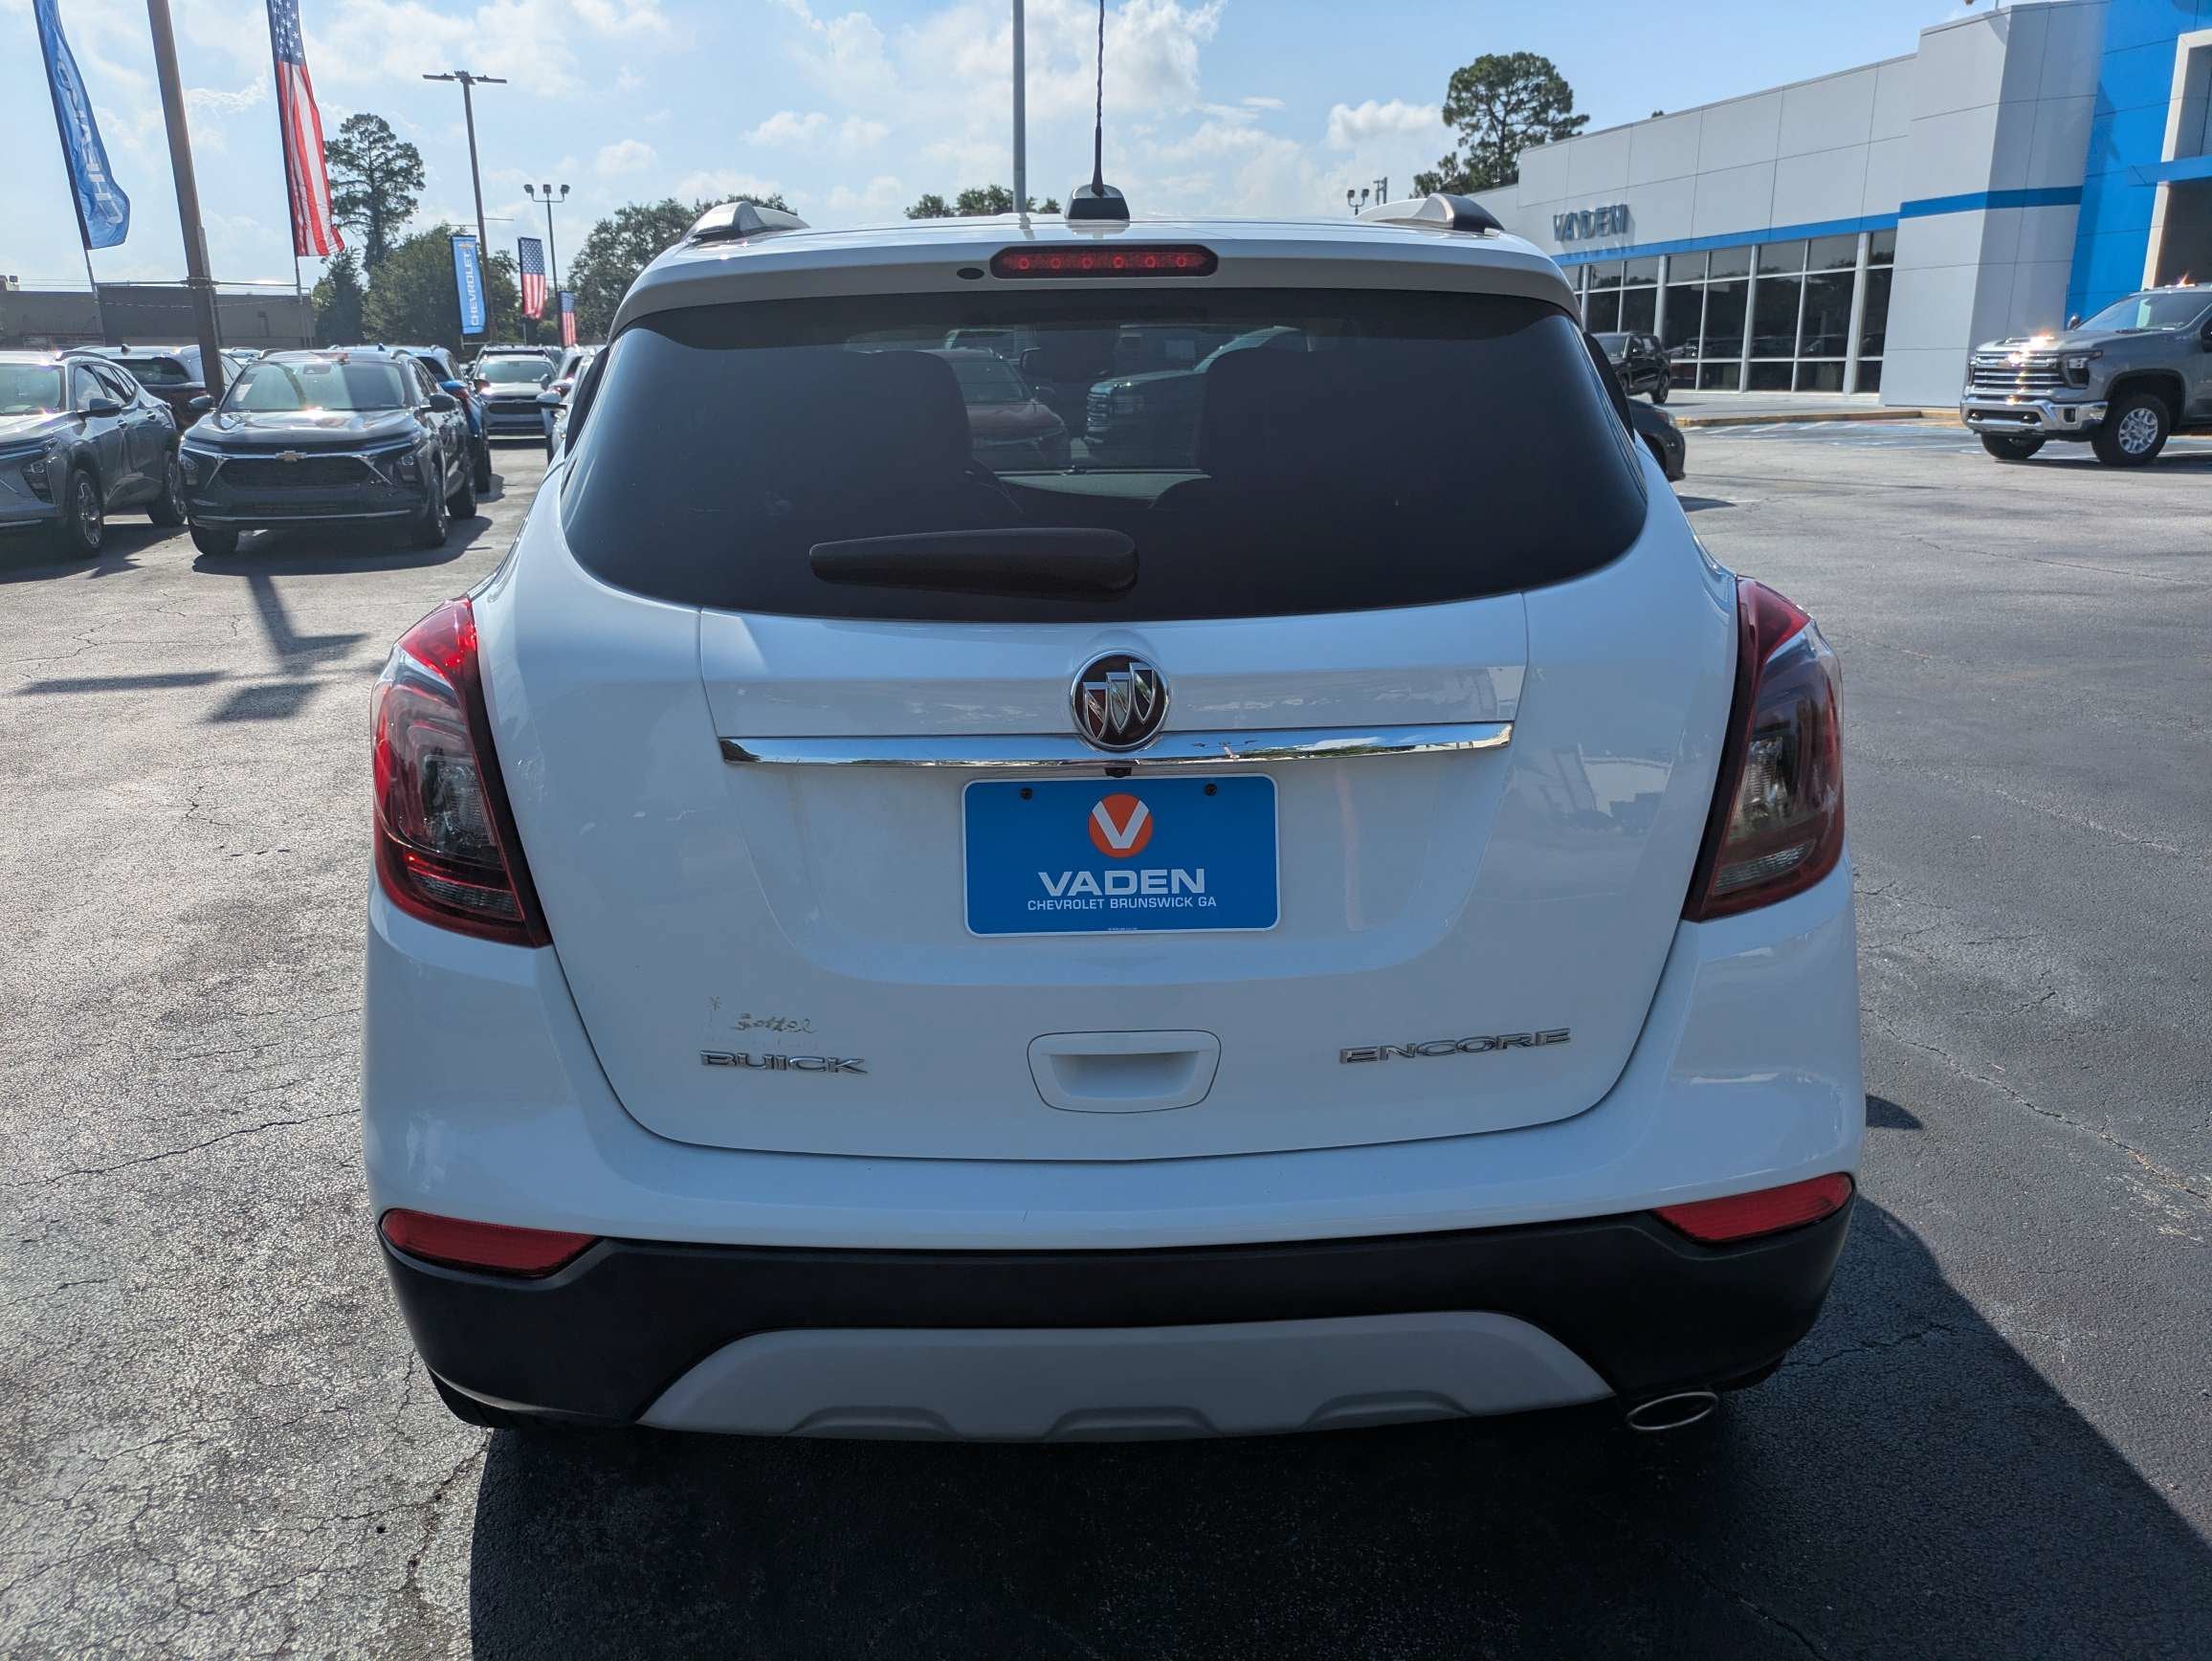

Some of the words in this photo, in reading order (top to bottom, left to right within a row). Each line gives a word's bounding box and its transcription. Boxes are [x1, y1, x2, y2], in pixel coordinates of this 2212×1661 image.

[1553, 204, 1629, 242] VADEN
[464, 251, 479, 326] CHEVROLET
[1038, 868, 1206, 897] VADEN
[1028, 898, 1104, 911] CHEVROLET
[1110, 897, 1193, 909] BRUNSWICK
[1198, 896, 1217, 908] GA
[700, 1050, 868, 1074] BUICK
[1339, 1027, 1571, 1064] ENCORE
